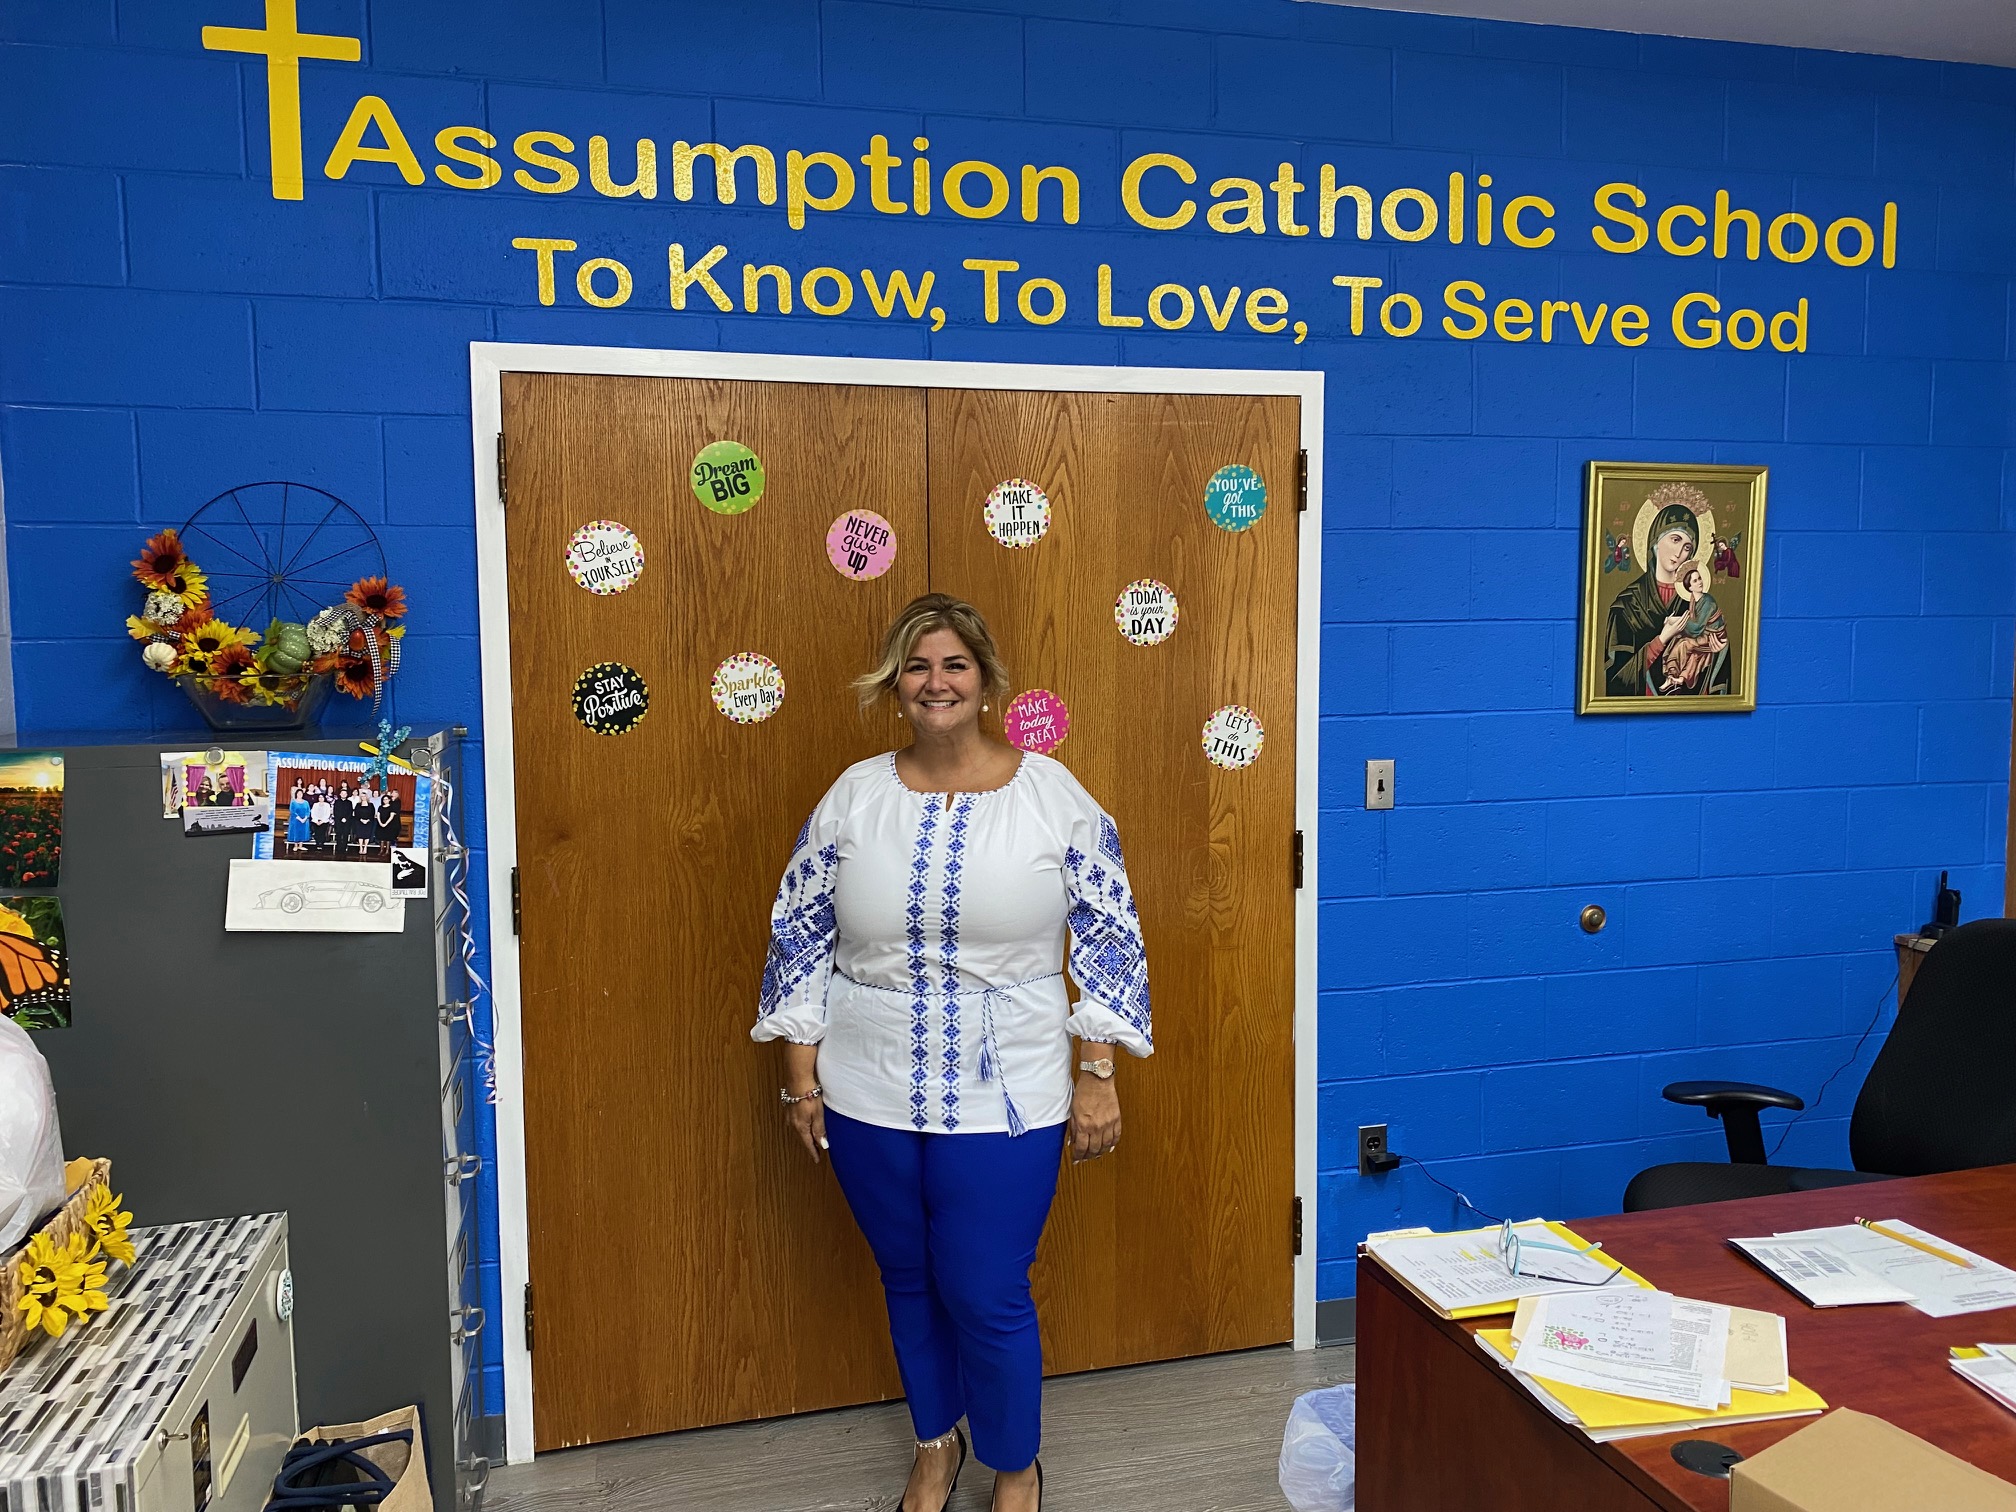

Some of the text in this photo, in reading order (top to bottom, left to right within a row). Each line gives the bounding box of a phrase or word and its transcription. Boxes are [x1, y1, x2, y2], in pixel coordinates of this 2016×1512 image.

[324, 95, 1898, 269] Assumption Catholic School
[511, 237, 1809, 353] To Know, To Love, To Serve God
[694, 456, 757, 486] Dream
[710, 473, 750, 502] BIG
[1214, 478, 1258, 492] YOU'VE
[1002, 490, 1033, 505] MAKE
[1223, 490, 1244, 514] got
[1011, 505, 1023, 520] IT
[1230, 505, 1257, 518] THIS
[846, 515, 889, 548] NEVER
[999, 520, 1040, 537] HAPPEN
[573, 539, 631, 563] Believe
[841, 534, 878, 555] give
[581, 556, 638, 587] YOURSELF
[1129, 589, 1163, 606] TODAY
[1130, 604, 1165, 620] is your
[1131, 617, 1165, 636] DAY
[594, 675, 626, 695] STAY
[718, 666, 777, 698] Sparkle
[583, 688, 644, 726] Positive
[733, 689, 776, 709] Every Day
[1017, 697, 1049, 718] MAKE
[1019, 713, 1055, 732] today
[1225, 714, 1252, 732] LET'S
[1023, 725, 1058, 747] GREAT
[1227, 731, 1239, 741] do
[1212, 737, 1247, 761] THIS
[276, 756, 336, 771] ASSUMPTION
